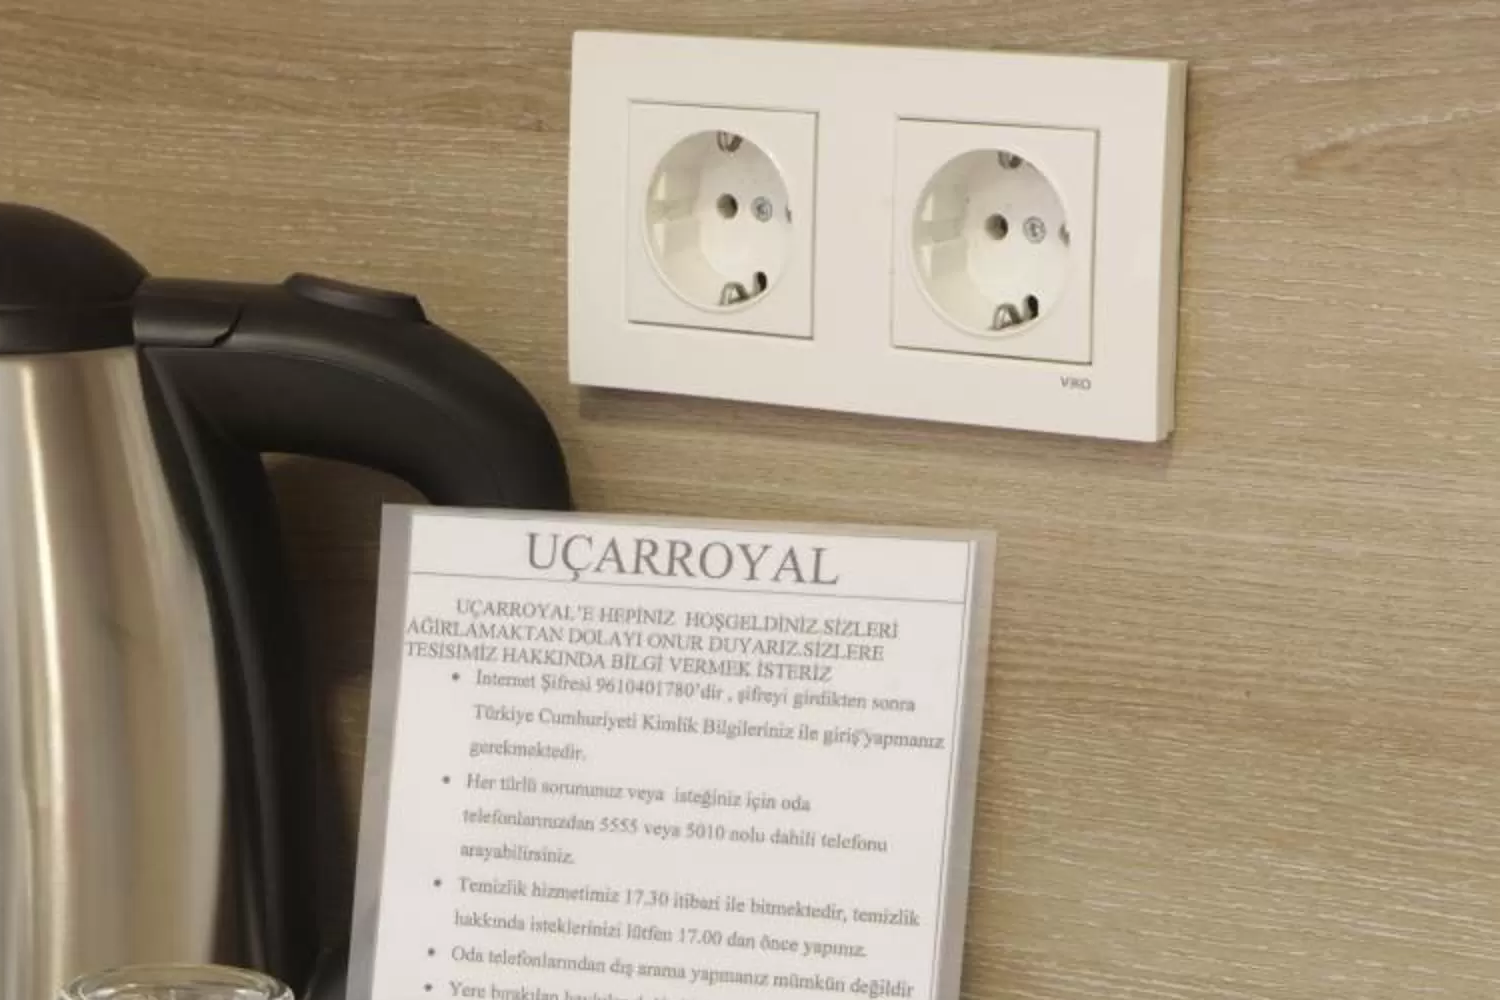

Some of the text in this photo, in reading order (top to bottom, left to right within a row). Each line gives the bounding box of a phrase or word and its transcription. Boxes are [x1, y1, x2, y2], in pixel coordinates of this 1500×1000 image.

[527, 532, 838, 586] UÇARROYAL
[645, 632, 705, 652] ONUR
[668, 655, 752, 678] VERMEK
[540, 672, 593, 694] Şifresi
[736, 684, 788, 709] şifreyi
[791, 689, 868, 710] girdikten
[871, 697, 917, 713] sonra
[473, 703, 535, 727] Türkiye
[537, 706, 638, 732] Cumhuriyeti
[641, 713, 699, 734] Kimlik
[702, 717, 795, 741] Bilgileriniz
[797, 722, 820, 742] ile
[466, 771, 498, 791] Her
[499, 774, 538, 794] türlü
[626, 786, 666, 806] veya
[674, 787, 742, 810] isteğiniz
[744, 791, 778, 813] için
[780, 794, 812, 813] oda
[598, 816, 639, 834] 5555
[643, 822, 682, 842] veya
[685, 821, 727, 841] 5010
[728, 825, 766, 844] nolu
[768, 827, 817, 848] dahili
[820, 832, 889, 853] telefonu
[459, 875, 528, 898] Temizlik
[530, 881, 621, 904] hizmetimiz
[724, 894, 746, 914] ile
[749, 897, 848, 924] bitmektedir,
[851, 907, 921, 928] temizlik
[454, 909, 526, 932] hakkında
[529, 915, 622, 939] isteklerinizi
[626, 922, 674, 943] lütfen
[678, 926, 724, 946] 17.00
[725, 930, 757, 951] dan
[758, 933, 800, 954] önce
[448, 979, 487, 1000] Yere
[450, 944, 485, 964] Oda
[487, 948, 606, 974] telefonlarından
[608, 957, 635, 979] dış
[636, 963, 687, 980] arama
[772, 972, 846, 993] mümkün
[848, 977, 915, 1000] değildir
